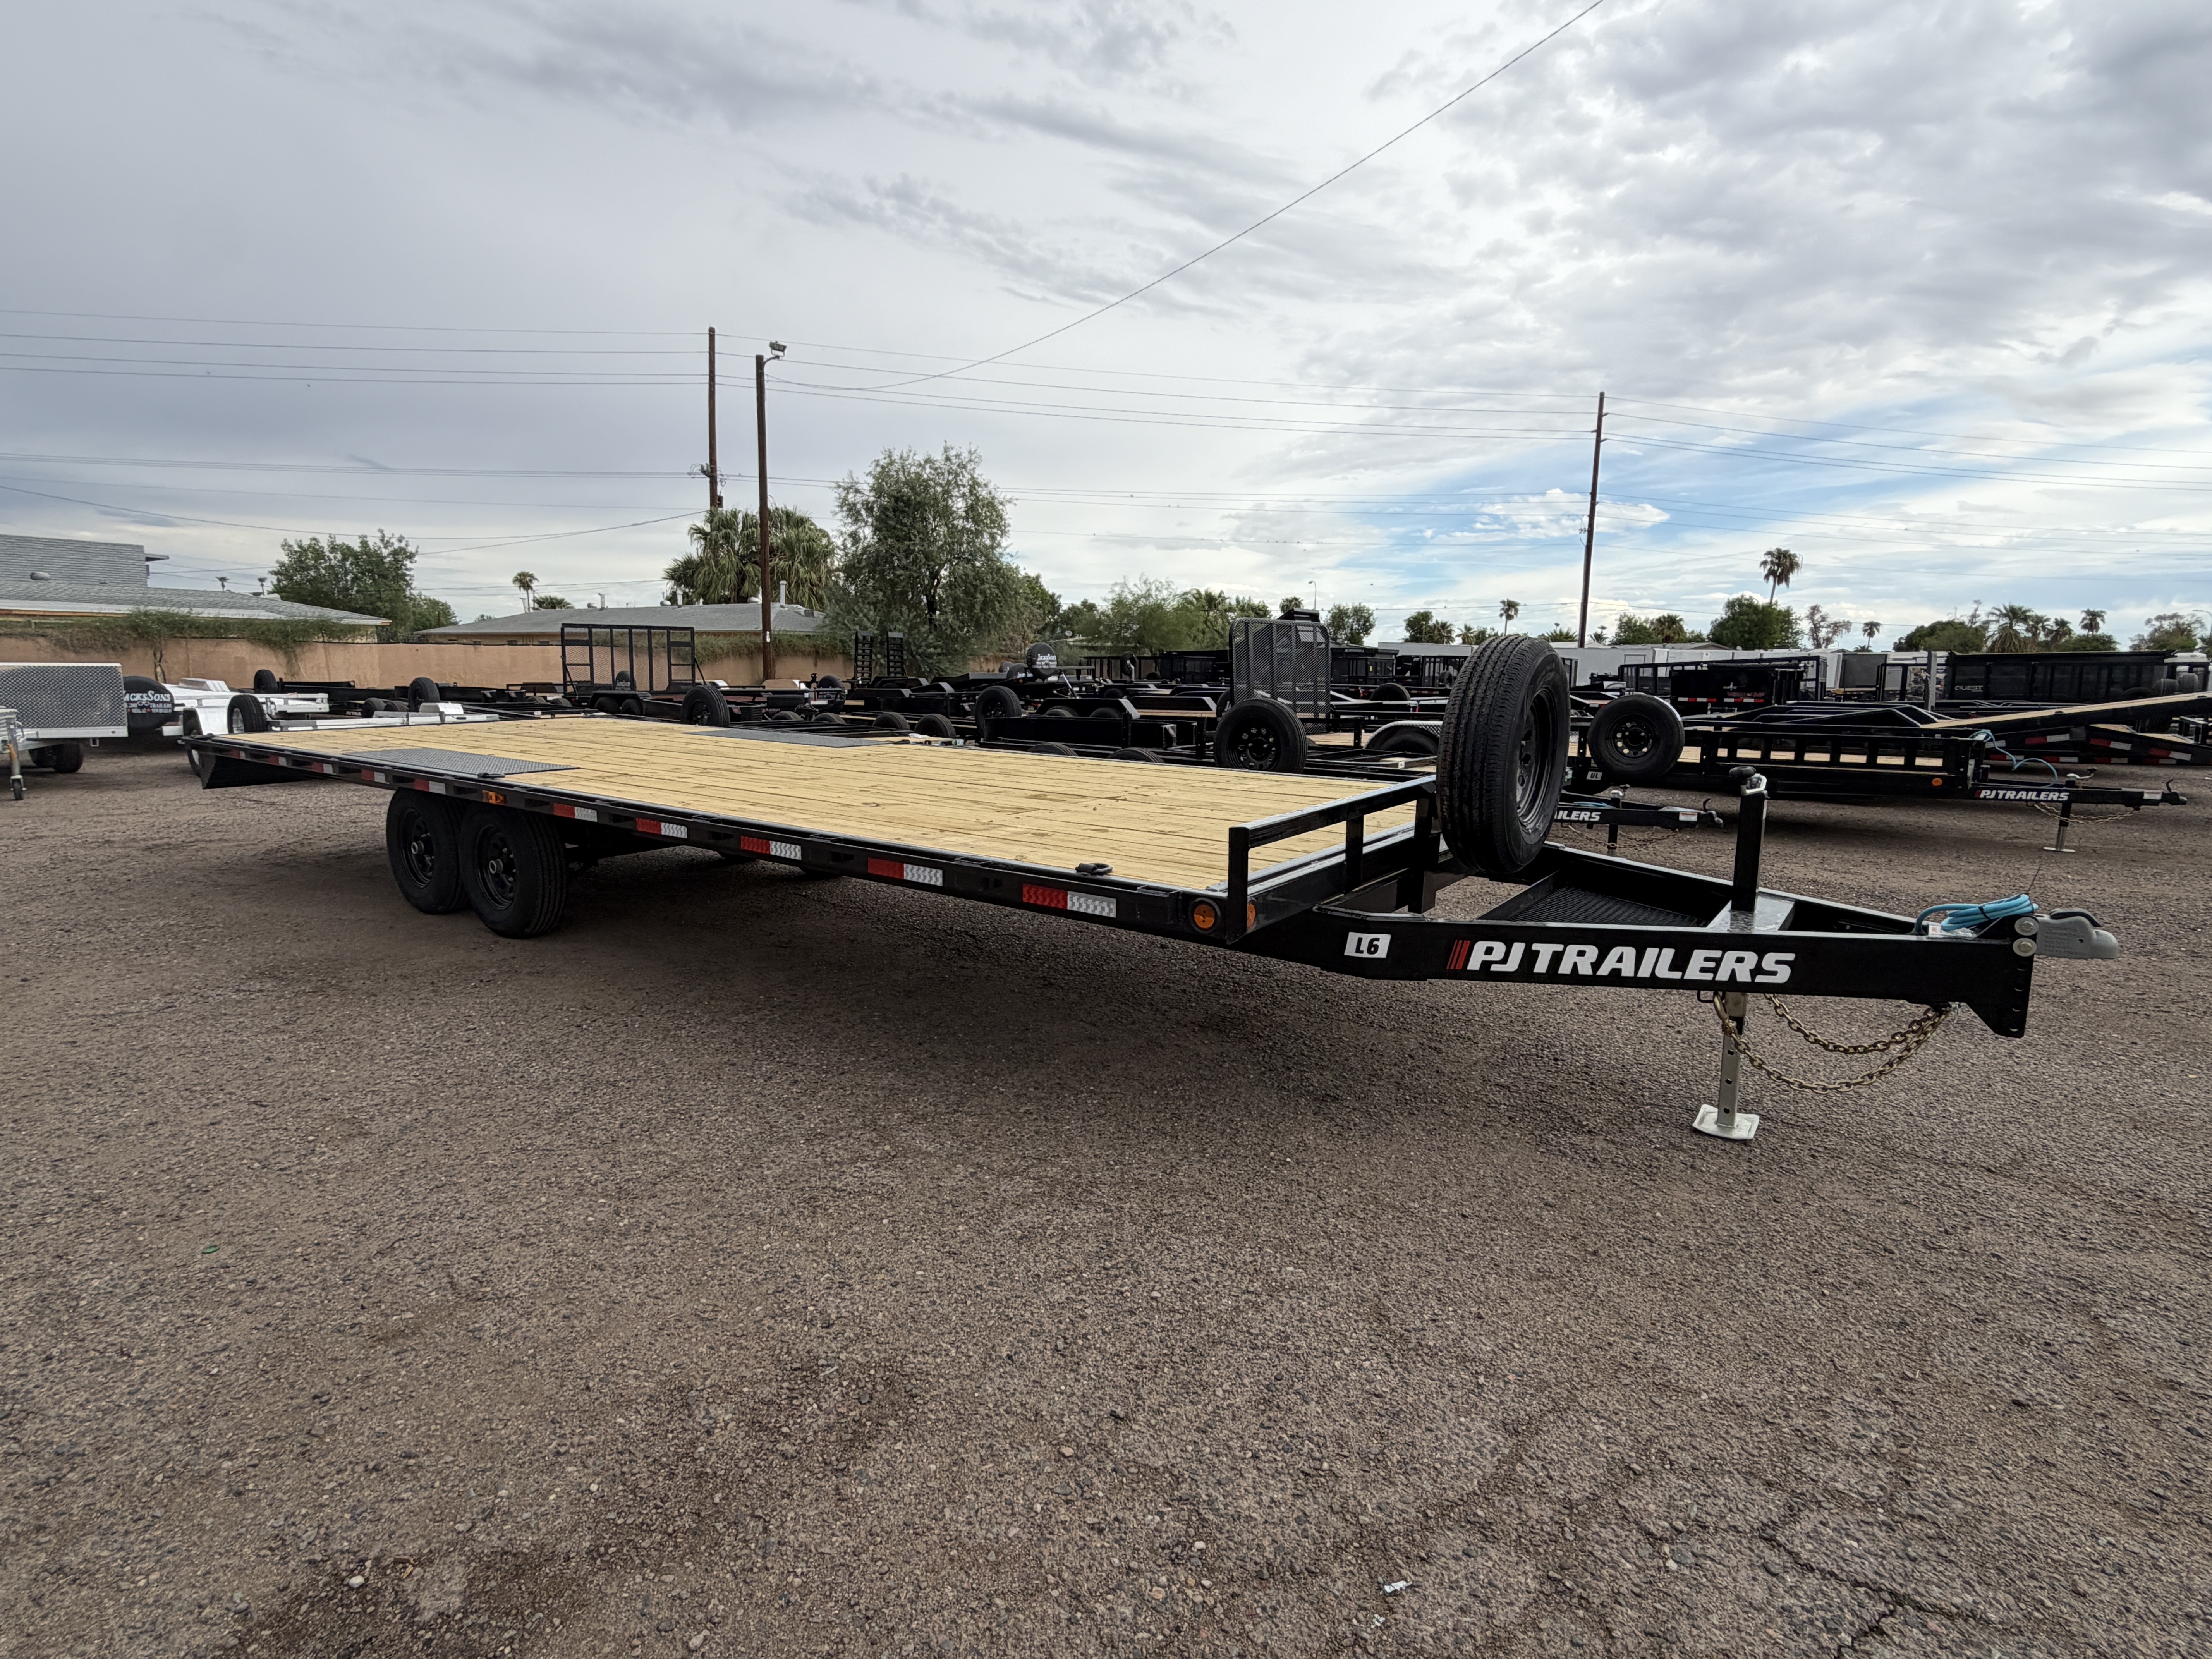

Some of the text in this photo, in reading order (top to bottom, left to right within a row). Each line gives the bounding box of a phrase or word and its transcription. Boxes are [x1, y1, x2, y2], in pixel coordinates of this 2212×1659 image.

[123, 690, 170, 701] ACKSSONS
[1997, 790, 2069, 800] TRAILERS
[1355, 937, 1380, 955] L6
[1467, 941, 1796, 983] PJ TRAILERS
